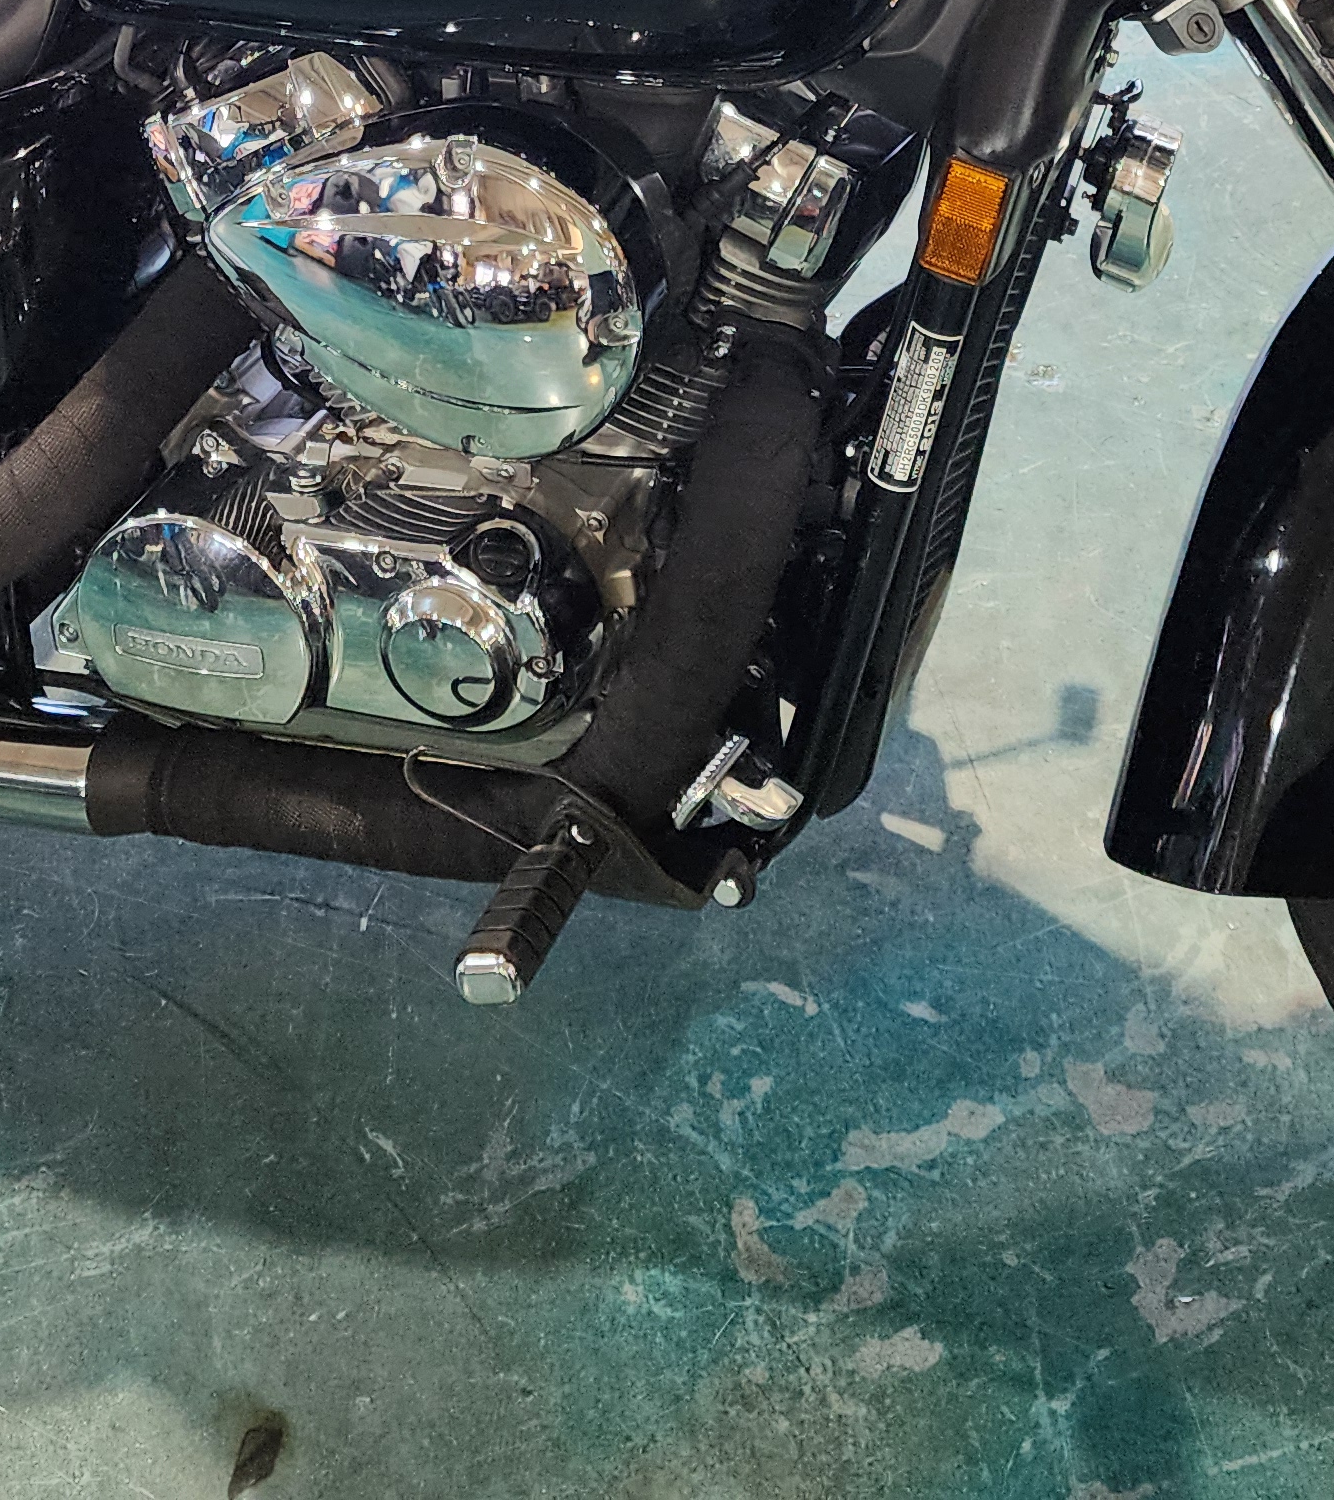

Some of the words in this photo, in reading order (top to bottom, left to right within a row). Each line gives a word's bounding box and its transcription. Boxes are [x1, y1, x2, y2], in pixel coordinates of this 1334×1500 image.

[897, 350, 944, 478] JH2RC5008DK900206
[919, 400, 942, 451] 2013
[127, 631, 249, 669] HONDA
